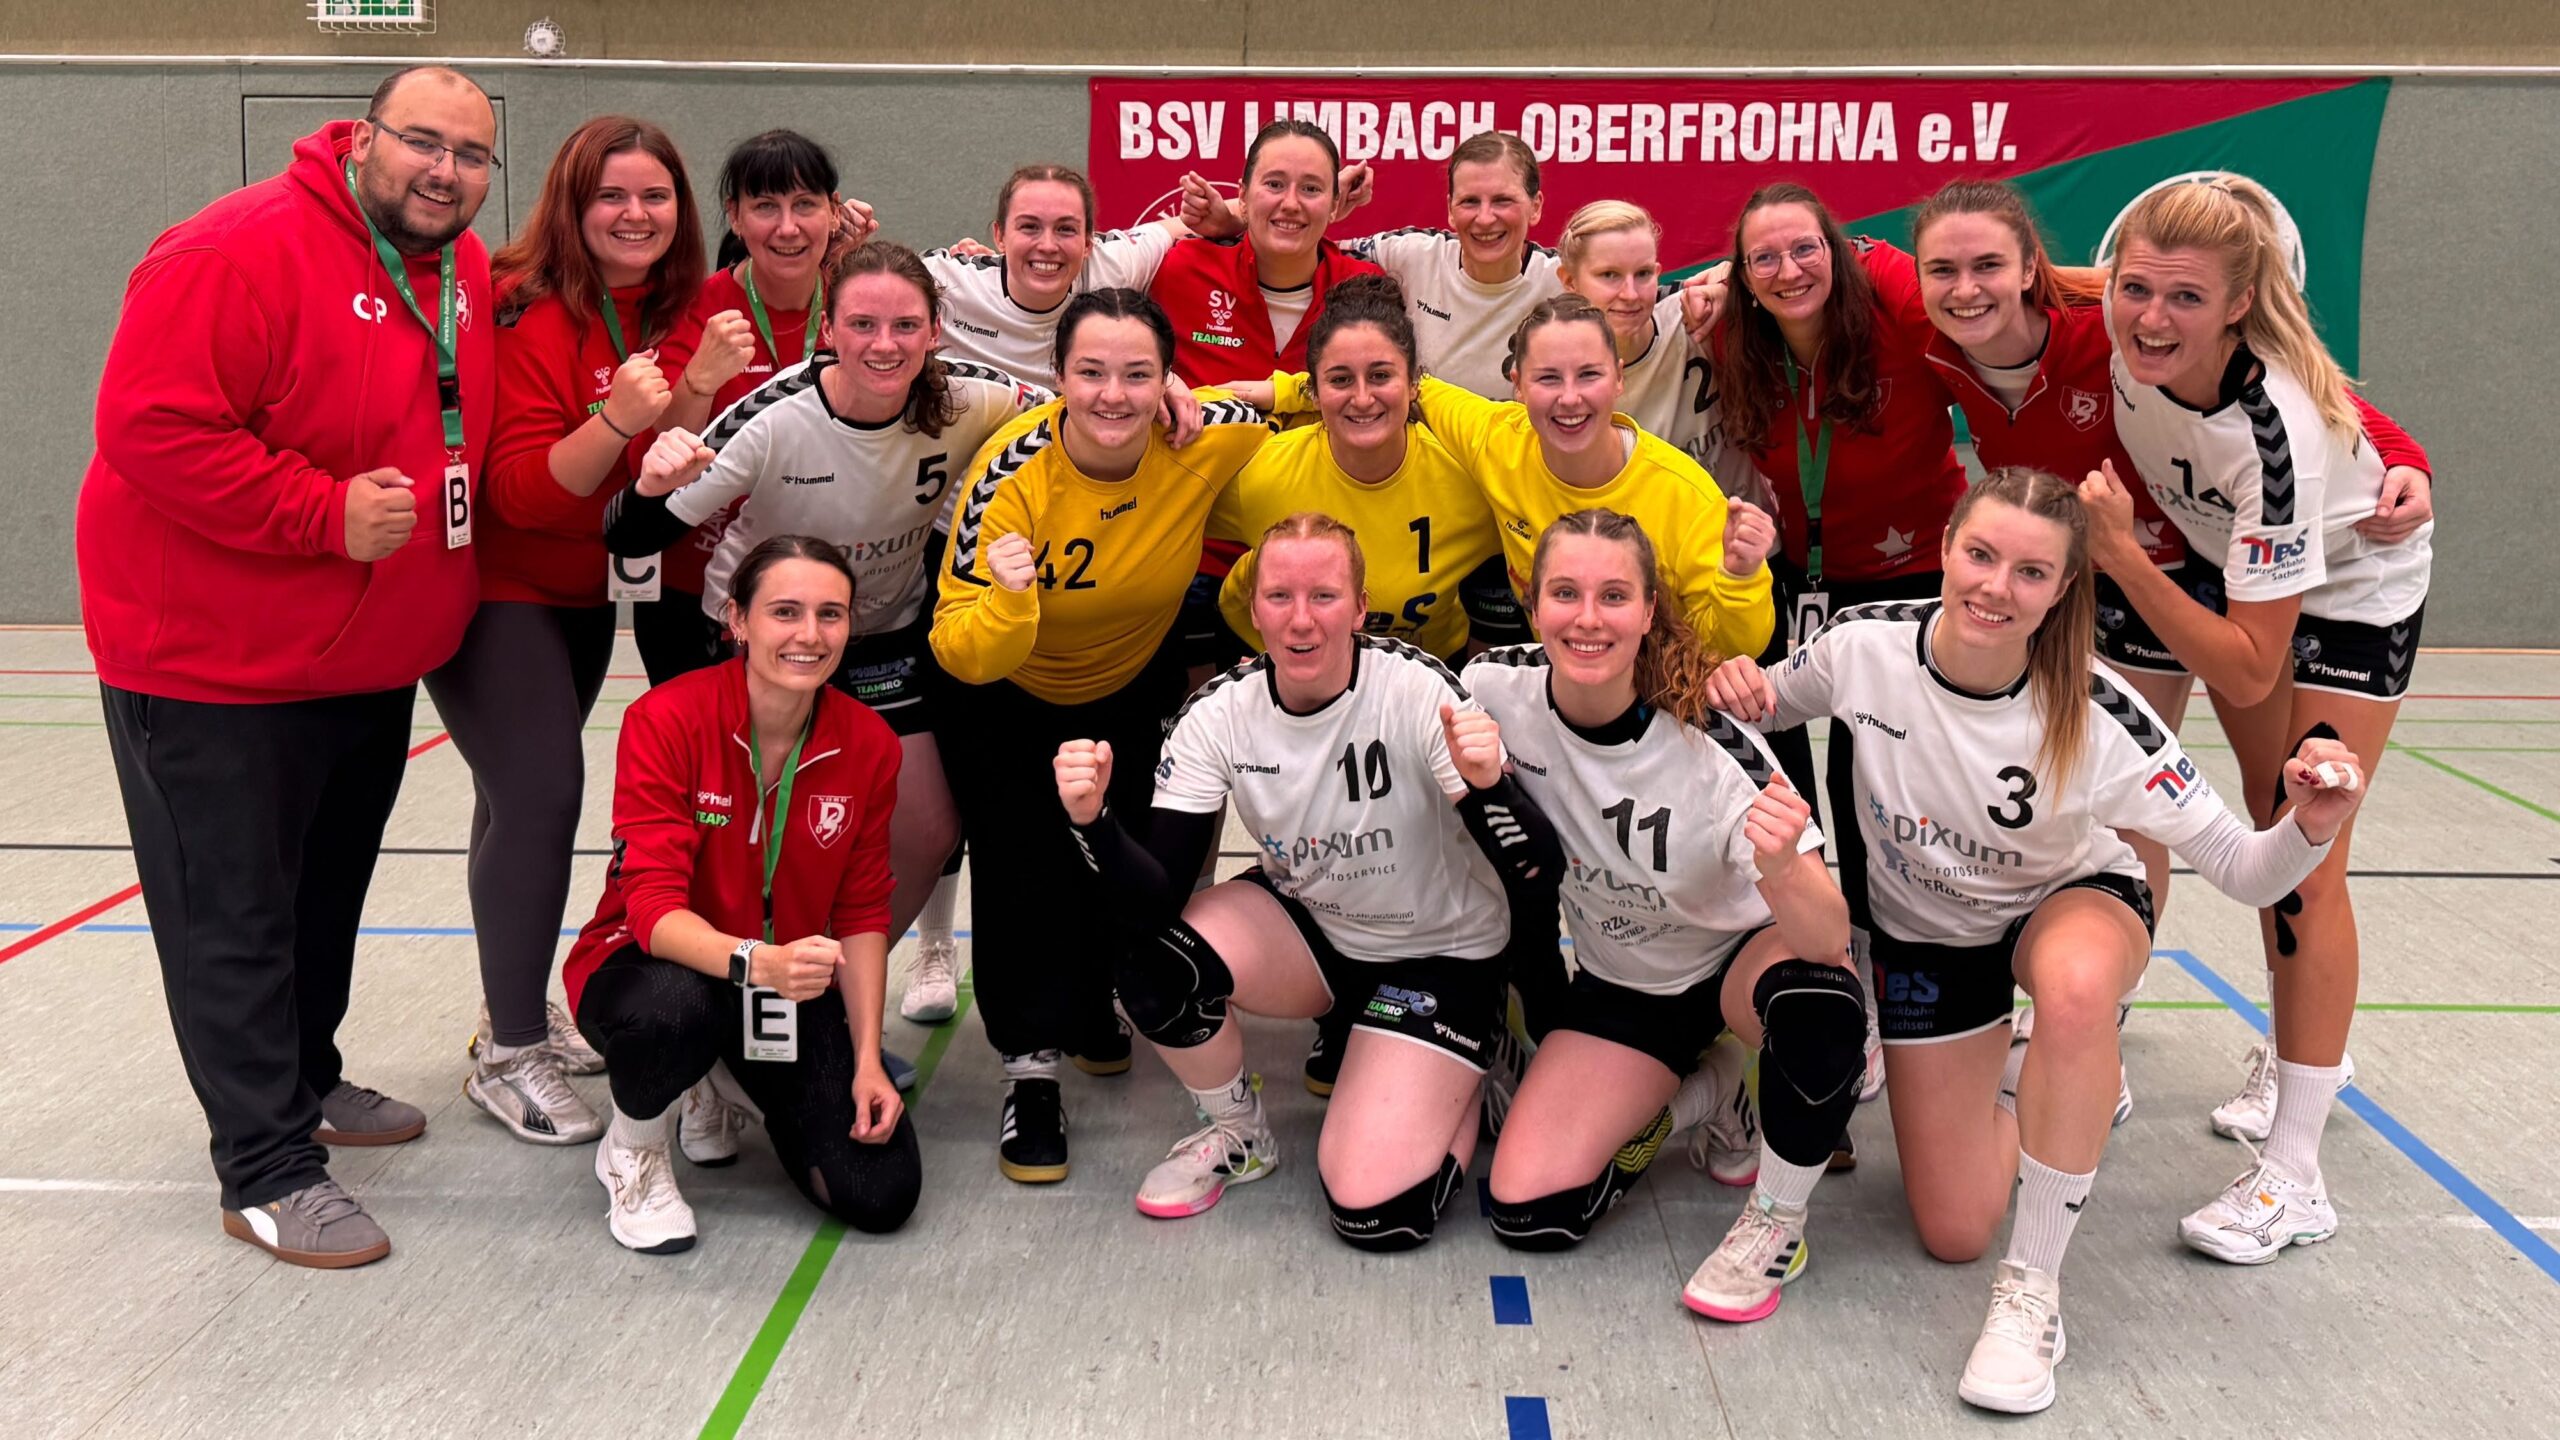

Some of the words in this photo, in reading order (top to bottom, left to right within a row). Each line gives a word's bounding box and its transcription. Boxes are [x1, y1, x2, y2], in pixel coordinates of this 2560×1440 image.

[1119, 101, 1226, 160] BSV
[1918, 102, 2017, 162] e.V.
[352, 292, 388, 324] CP
[1208, 289, 1237, 310] SV
[1423, 303, 1452, 321] hummel
[963, 321, 999, 338] hummel
[1206, 322, 1234, 333] hummel
[795, 472, 835, 486] hummel
[914, 451, 948, 505] 5
[449, 476, 468, 529] B
[1100, 496, 1138, 521] hummel
[1505, 520, 1532, 541] hummel
[1409, 516, 1431, 574] 1
[1034, 538, 1097, 590] 42
[2321, 663, 2371, 682] hummel
[1868, 714, 1907, 740] hummel
[1246, 763, 1280, 775] hummel
[1336, 738, 1392, 802] 10
[1513, 757, 1547, 777] hummel
[1987, 765, 2037, 830] 3
[1601, 797, 1672, 873] 11
[1894, 813, 2023, 868] pixum
[752, 990, 790, 1042] E
[1367, 1000, 1407, 1017] TEAMBRO
[1446, 1026, 1481, 1052] hummel
